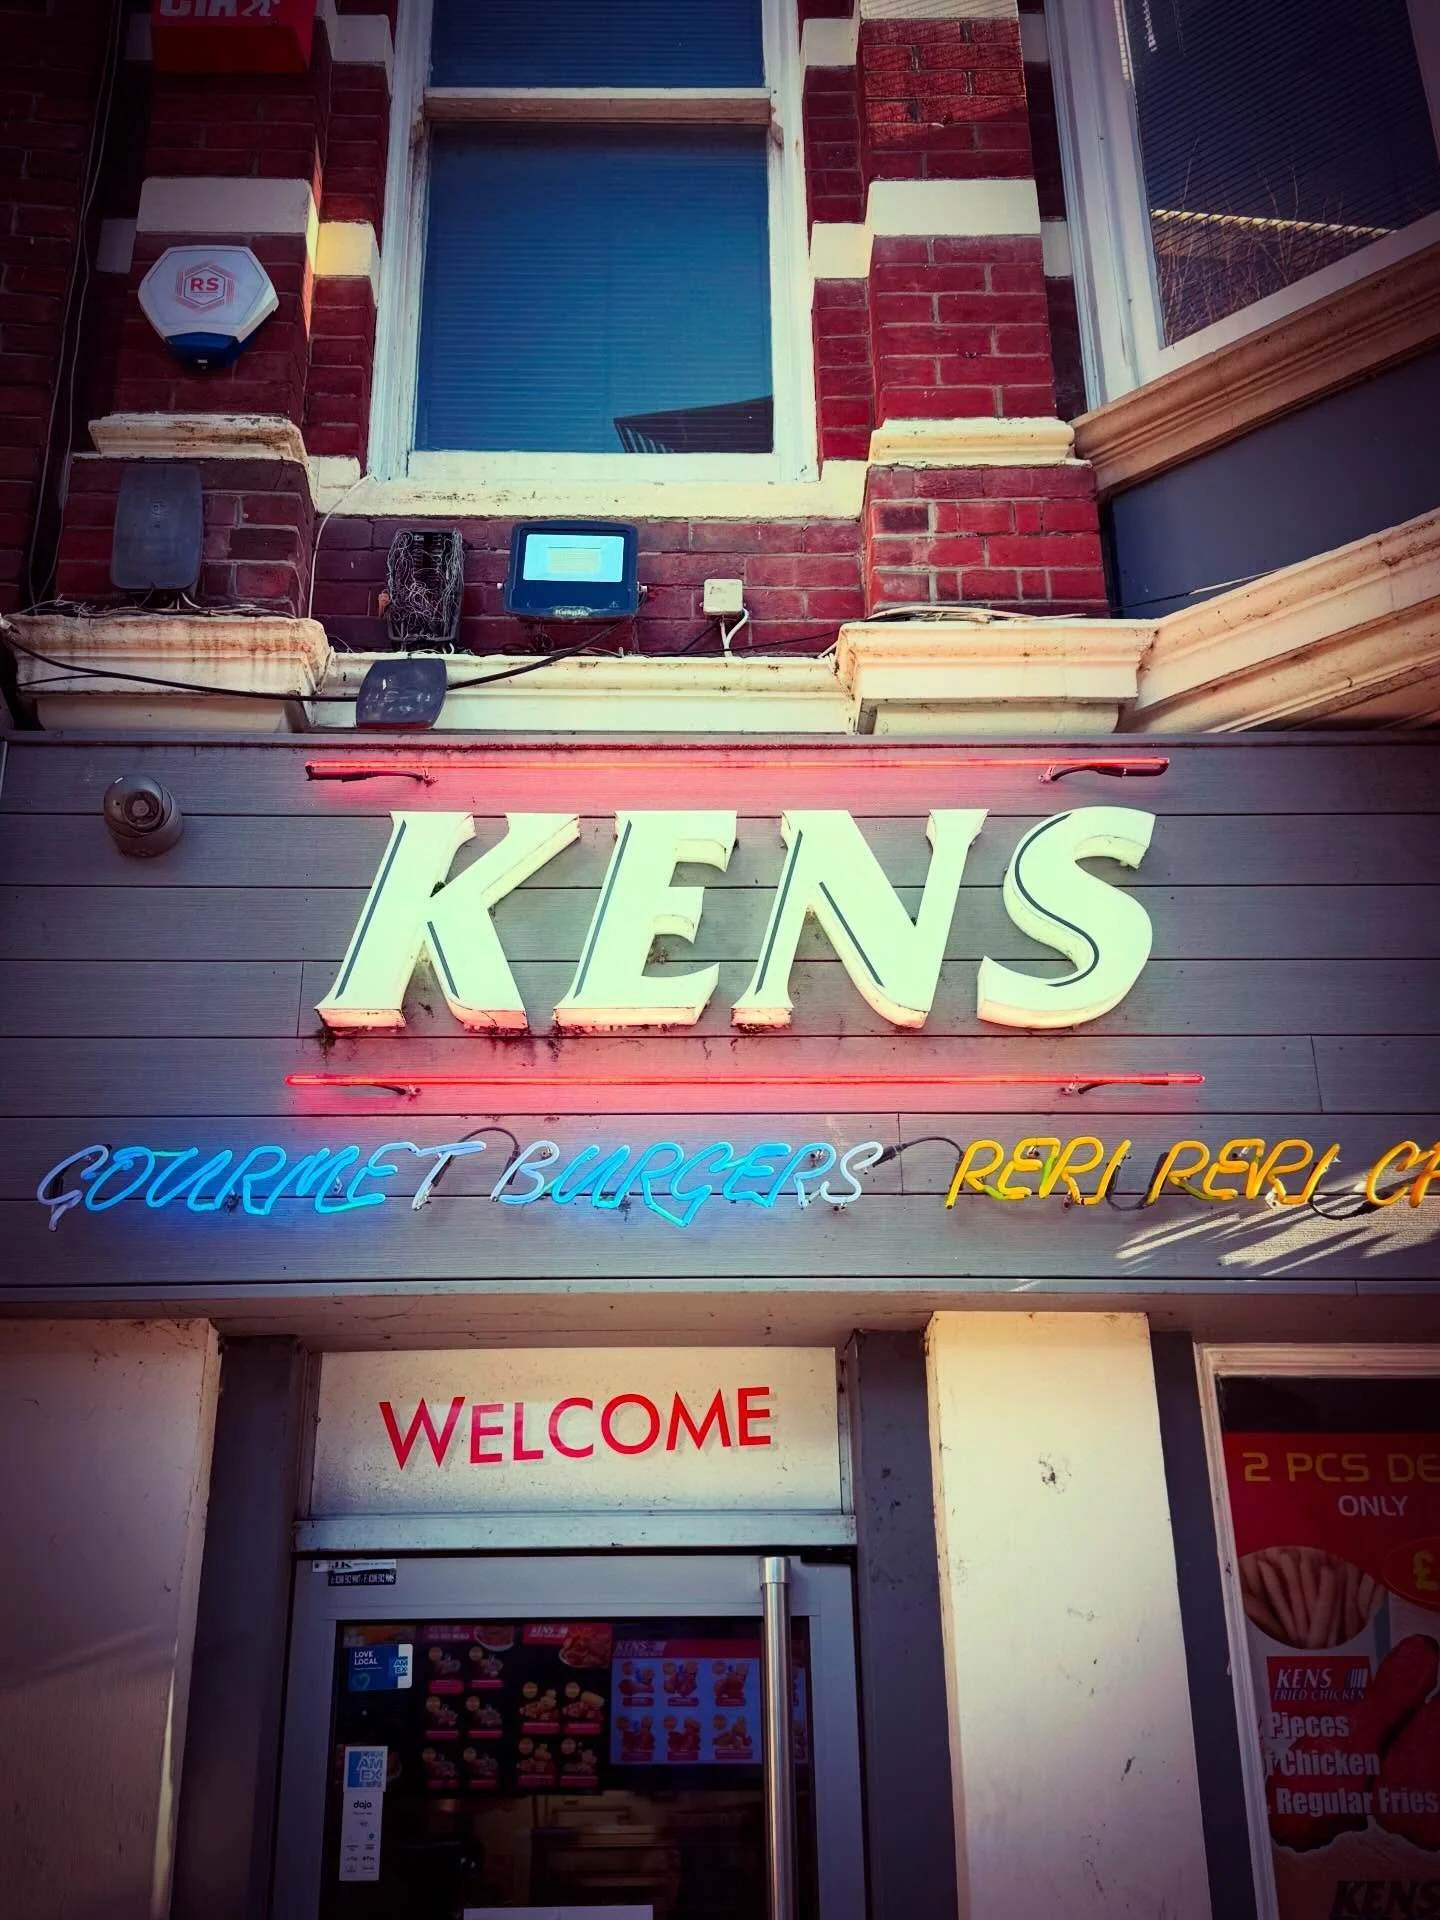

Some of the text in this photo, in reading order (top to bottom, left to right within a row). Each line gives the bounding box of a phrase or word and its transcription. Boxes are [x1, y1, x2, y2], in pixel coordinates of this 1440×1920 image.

[191, 278, 219, 290] RS
[318, 806, 1157, 1029] KENS
[37, 1140, 487, 1231] GOURMET
[490, 1140, 885, 1228] BURGERS
[379, 1386, 772, 1471] WELCOME
[1241, 1451, 1272, 1483] 2
[1285, 1451, 1372, 1483] PCS
[1337, 1494, 1409, 1517] ONLY
[1276, 1667, 1333, 1689] KENS
[1270, 1711, 1350, 1738] Pieces
[1280, 1748, 1381, 1776] Chicken
[1276, 1788, 1373, 1818] Regular
[1378, 1787, 1440, 1815] Fries
